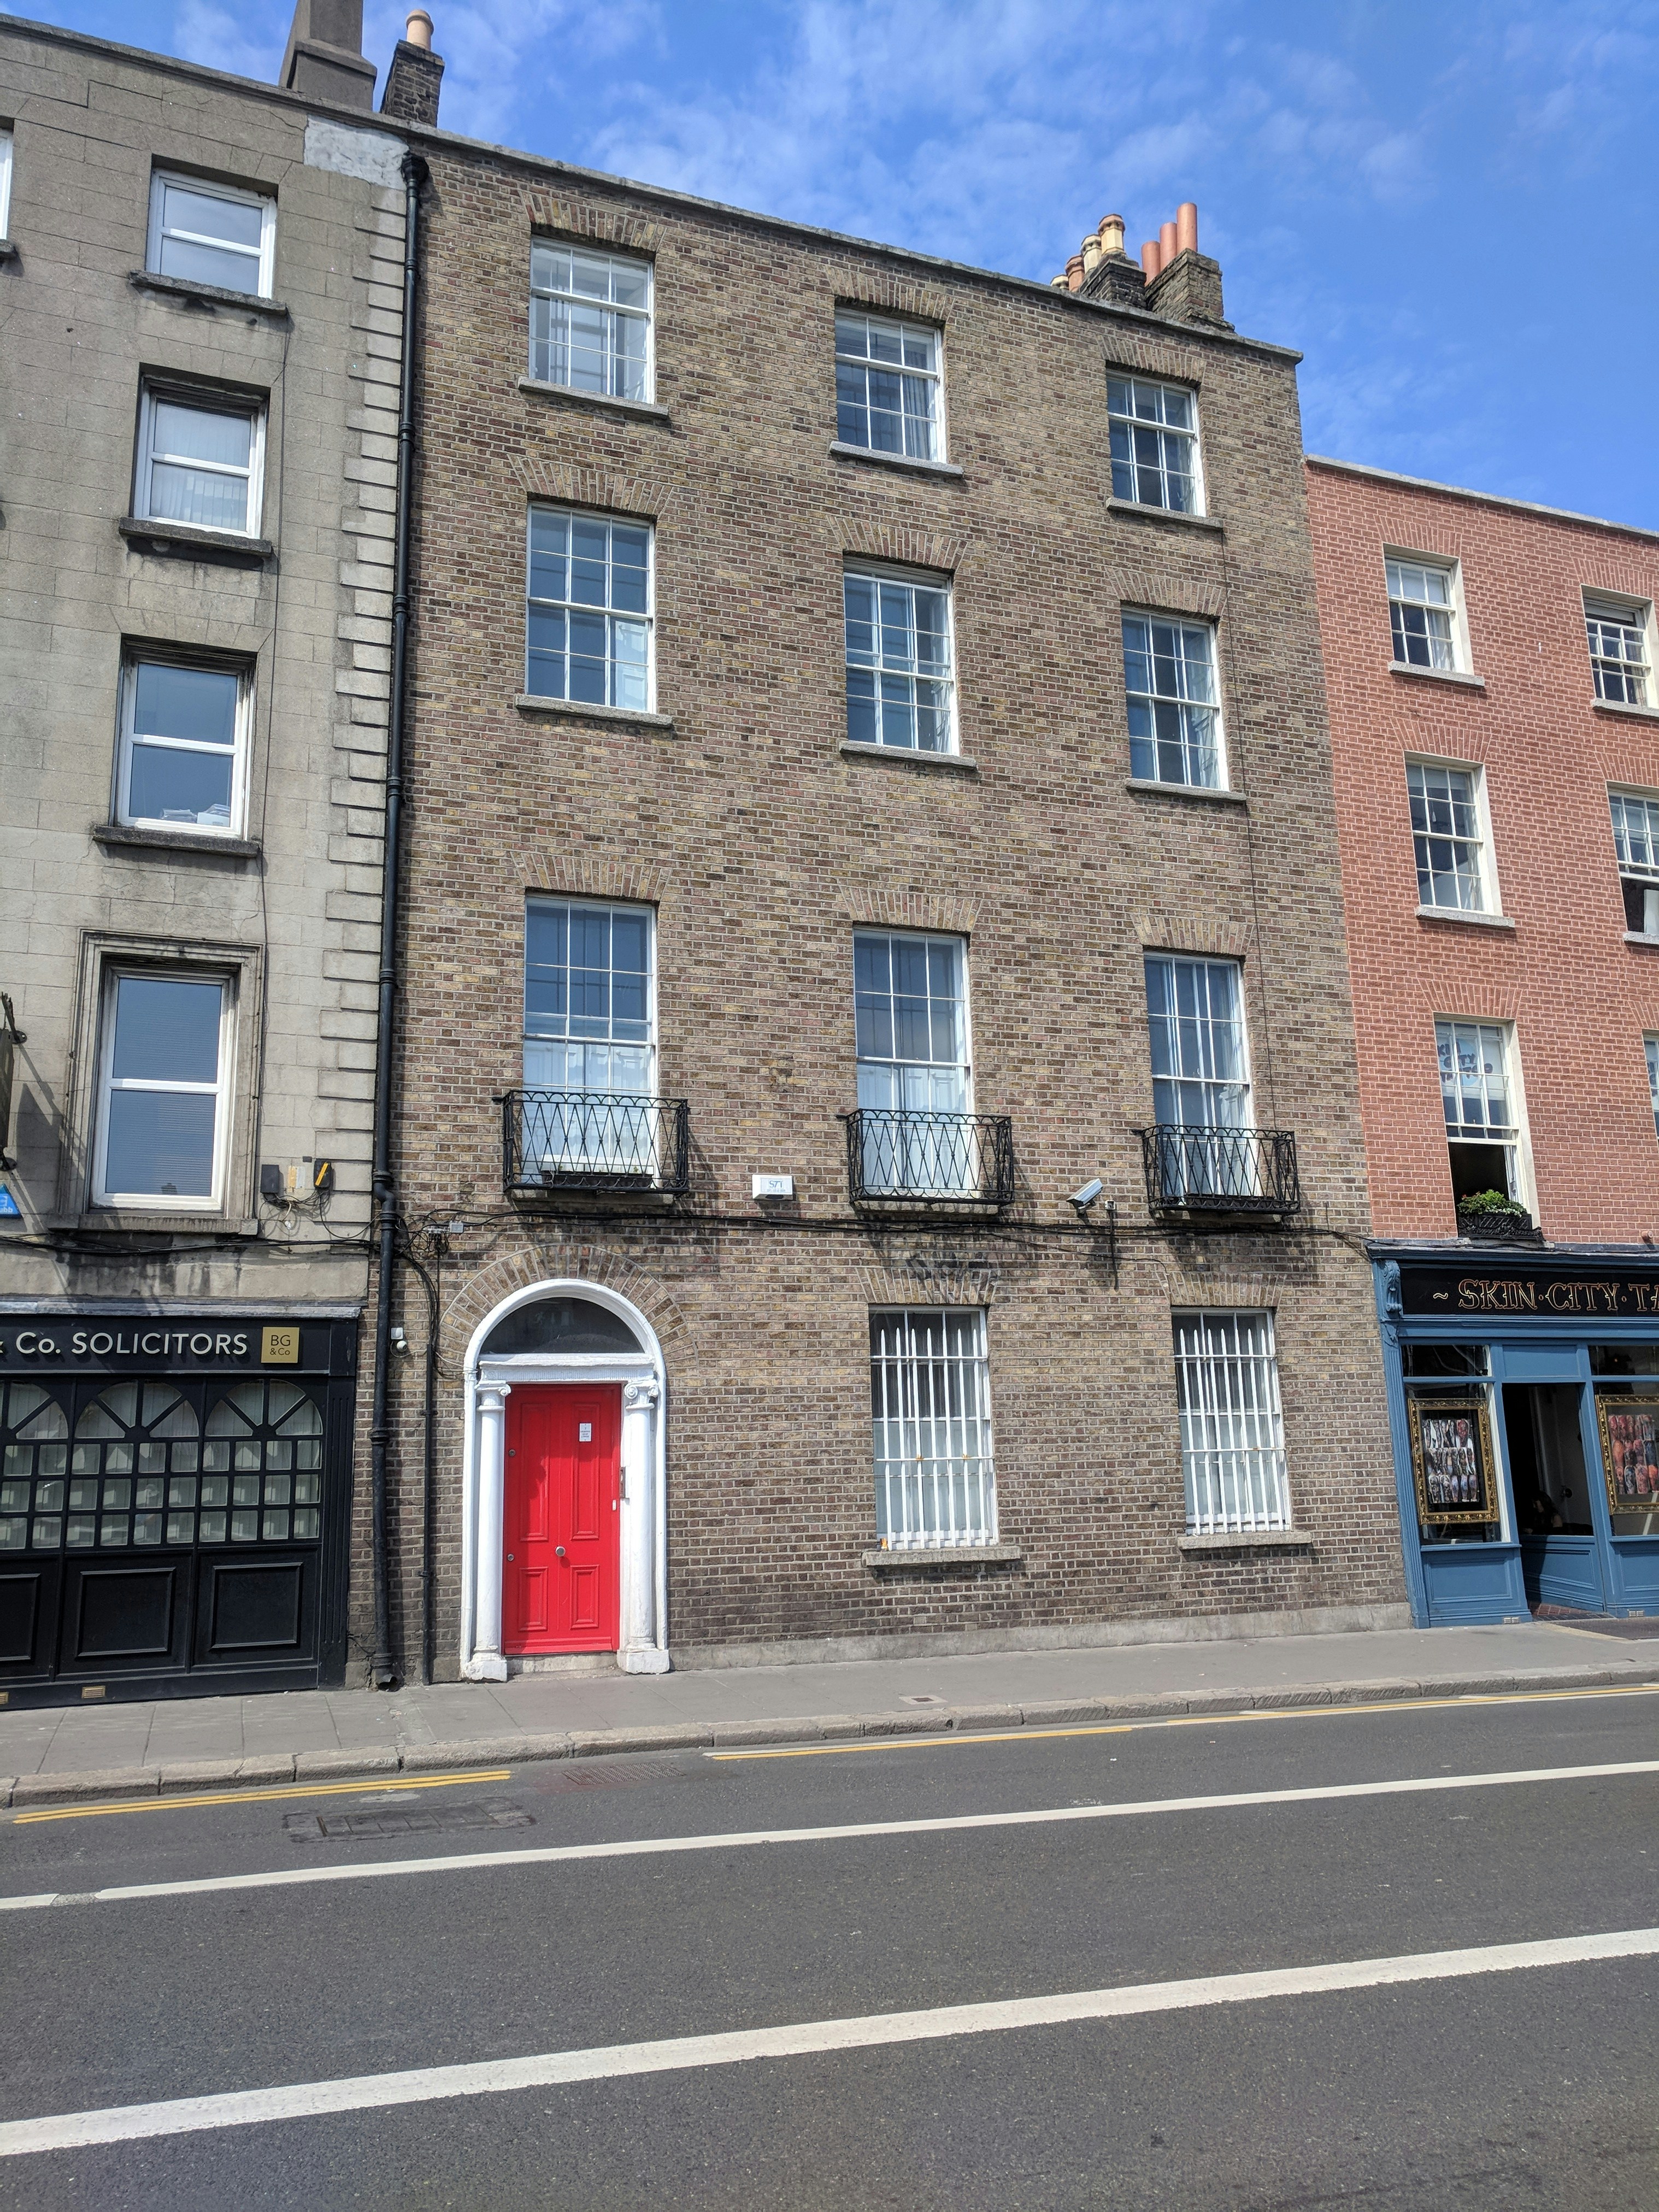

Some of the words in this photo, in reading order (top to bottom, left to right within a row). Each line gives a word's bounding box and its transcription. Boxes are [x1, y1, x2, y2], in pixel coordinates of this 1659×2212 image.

[1443, 1053, 1475, 1068] CTY
[1458, 1279, 1538, 1310] SKIN
[1545, 1283, 1620, 1310] CITY
[16, 1332, 61, 1354] Co.
[72, 1332, 248, 1355] SOLICITORS
[271, 1334, 291, 1346] BG
